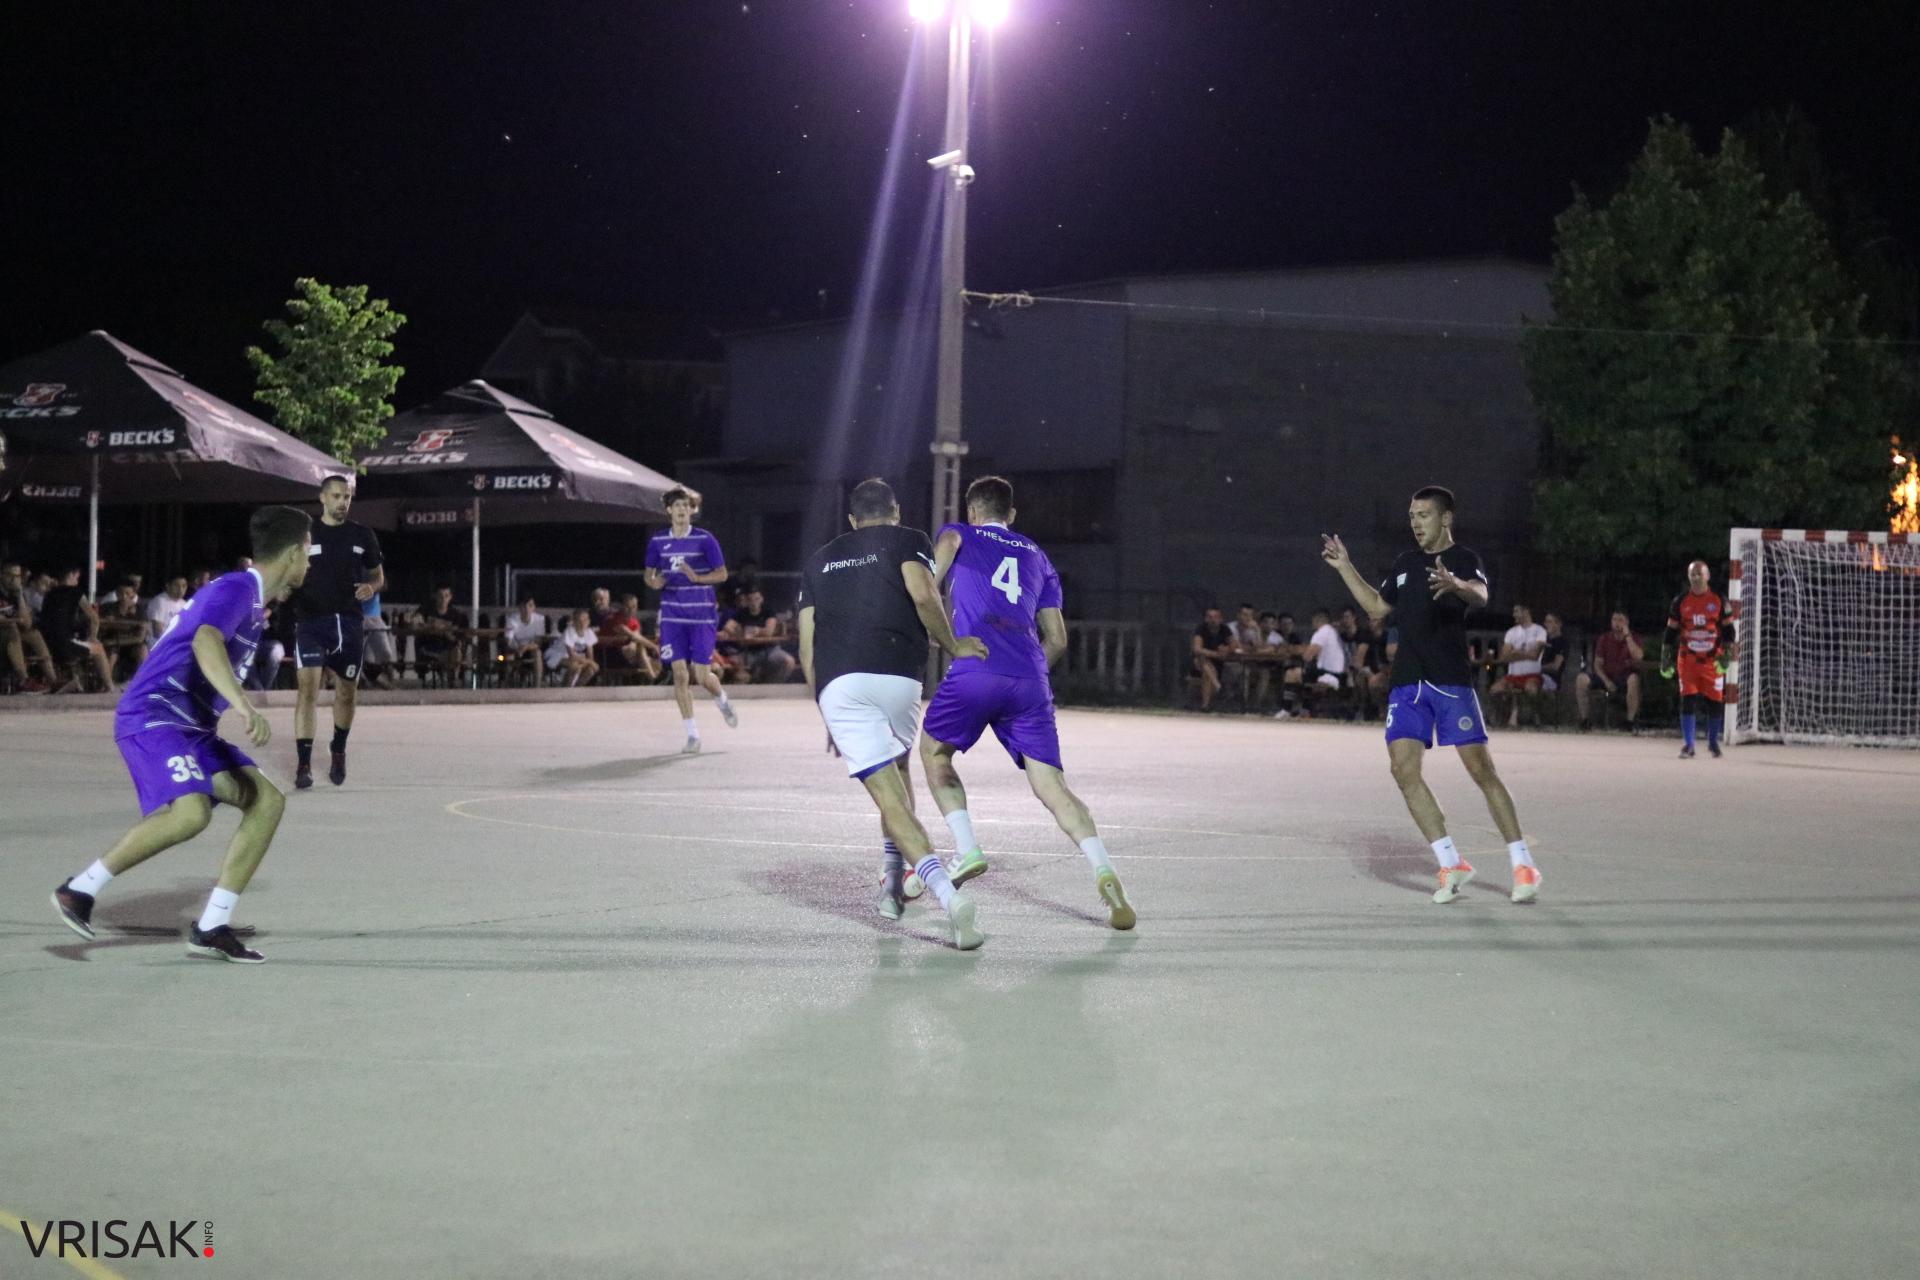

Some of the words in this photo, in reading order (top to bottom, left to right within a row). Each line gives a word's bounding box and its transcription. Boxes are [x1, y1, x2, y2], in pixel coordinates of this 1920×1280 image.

[109, 428, 175, 446] BECK'S
[360, 452, 468, 466] BECK'S
[493, 474, 552, 489] BECK'S
[991, 556, 1022, 605] 4
[166, 754, 205, 783] 35
